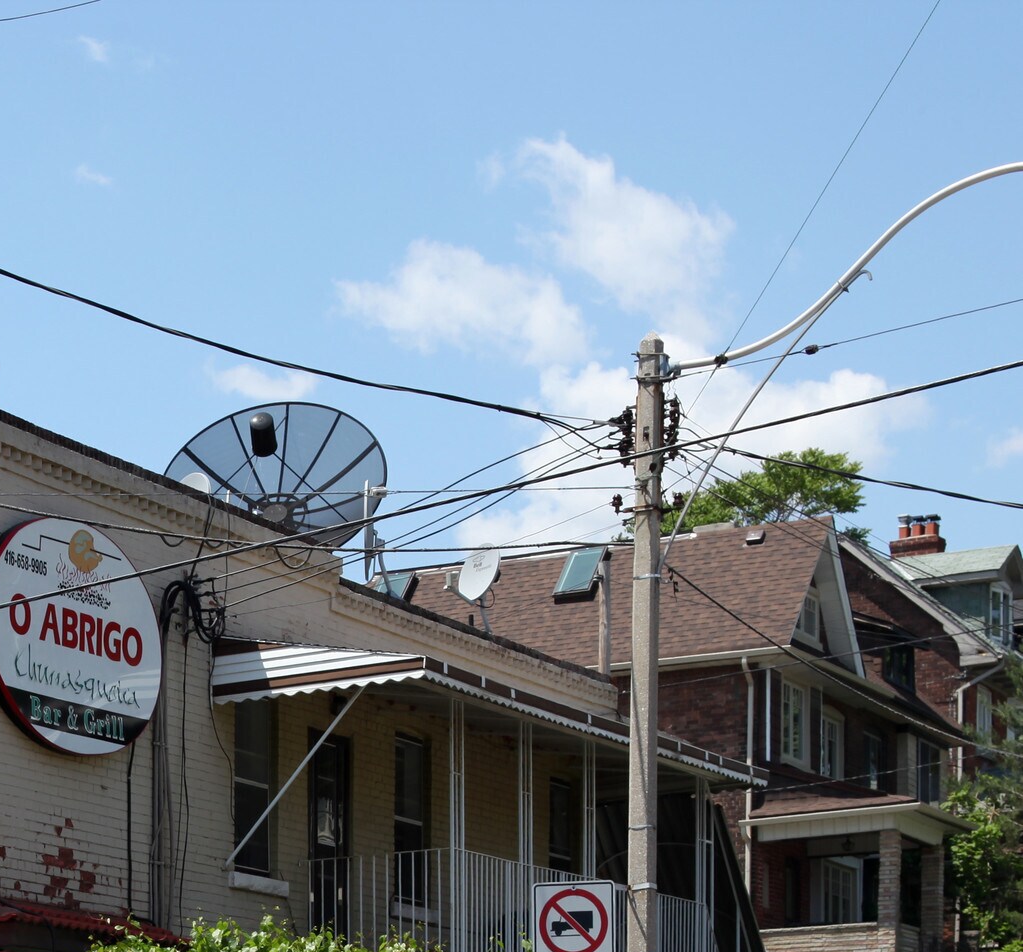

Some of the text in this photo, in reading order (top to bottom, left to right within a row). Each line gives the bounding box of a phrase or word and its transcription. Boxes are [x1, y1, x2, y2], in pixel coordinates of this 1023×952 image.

[4, 550, 48, 577] 416-658-9905
[9, 593, 143, 667] O ABRIGO
[30, 694, 125, 741] Bar & Grill
